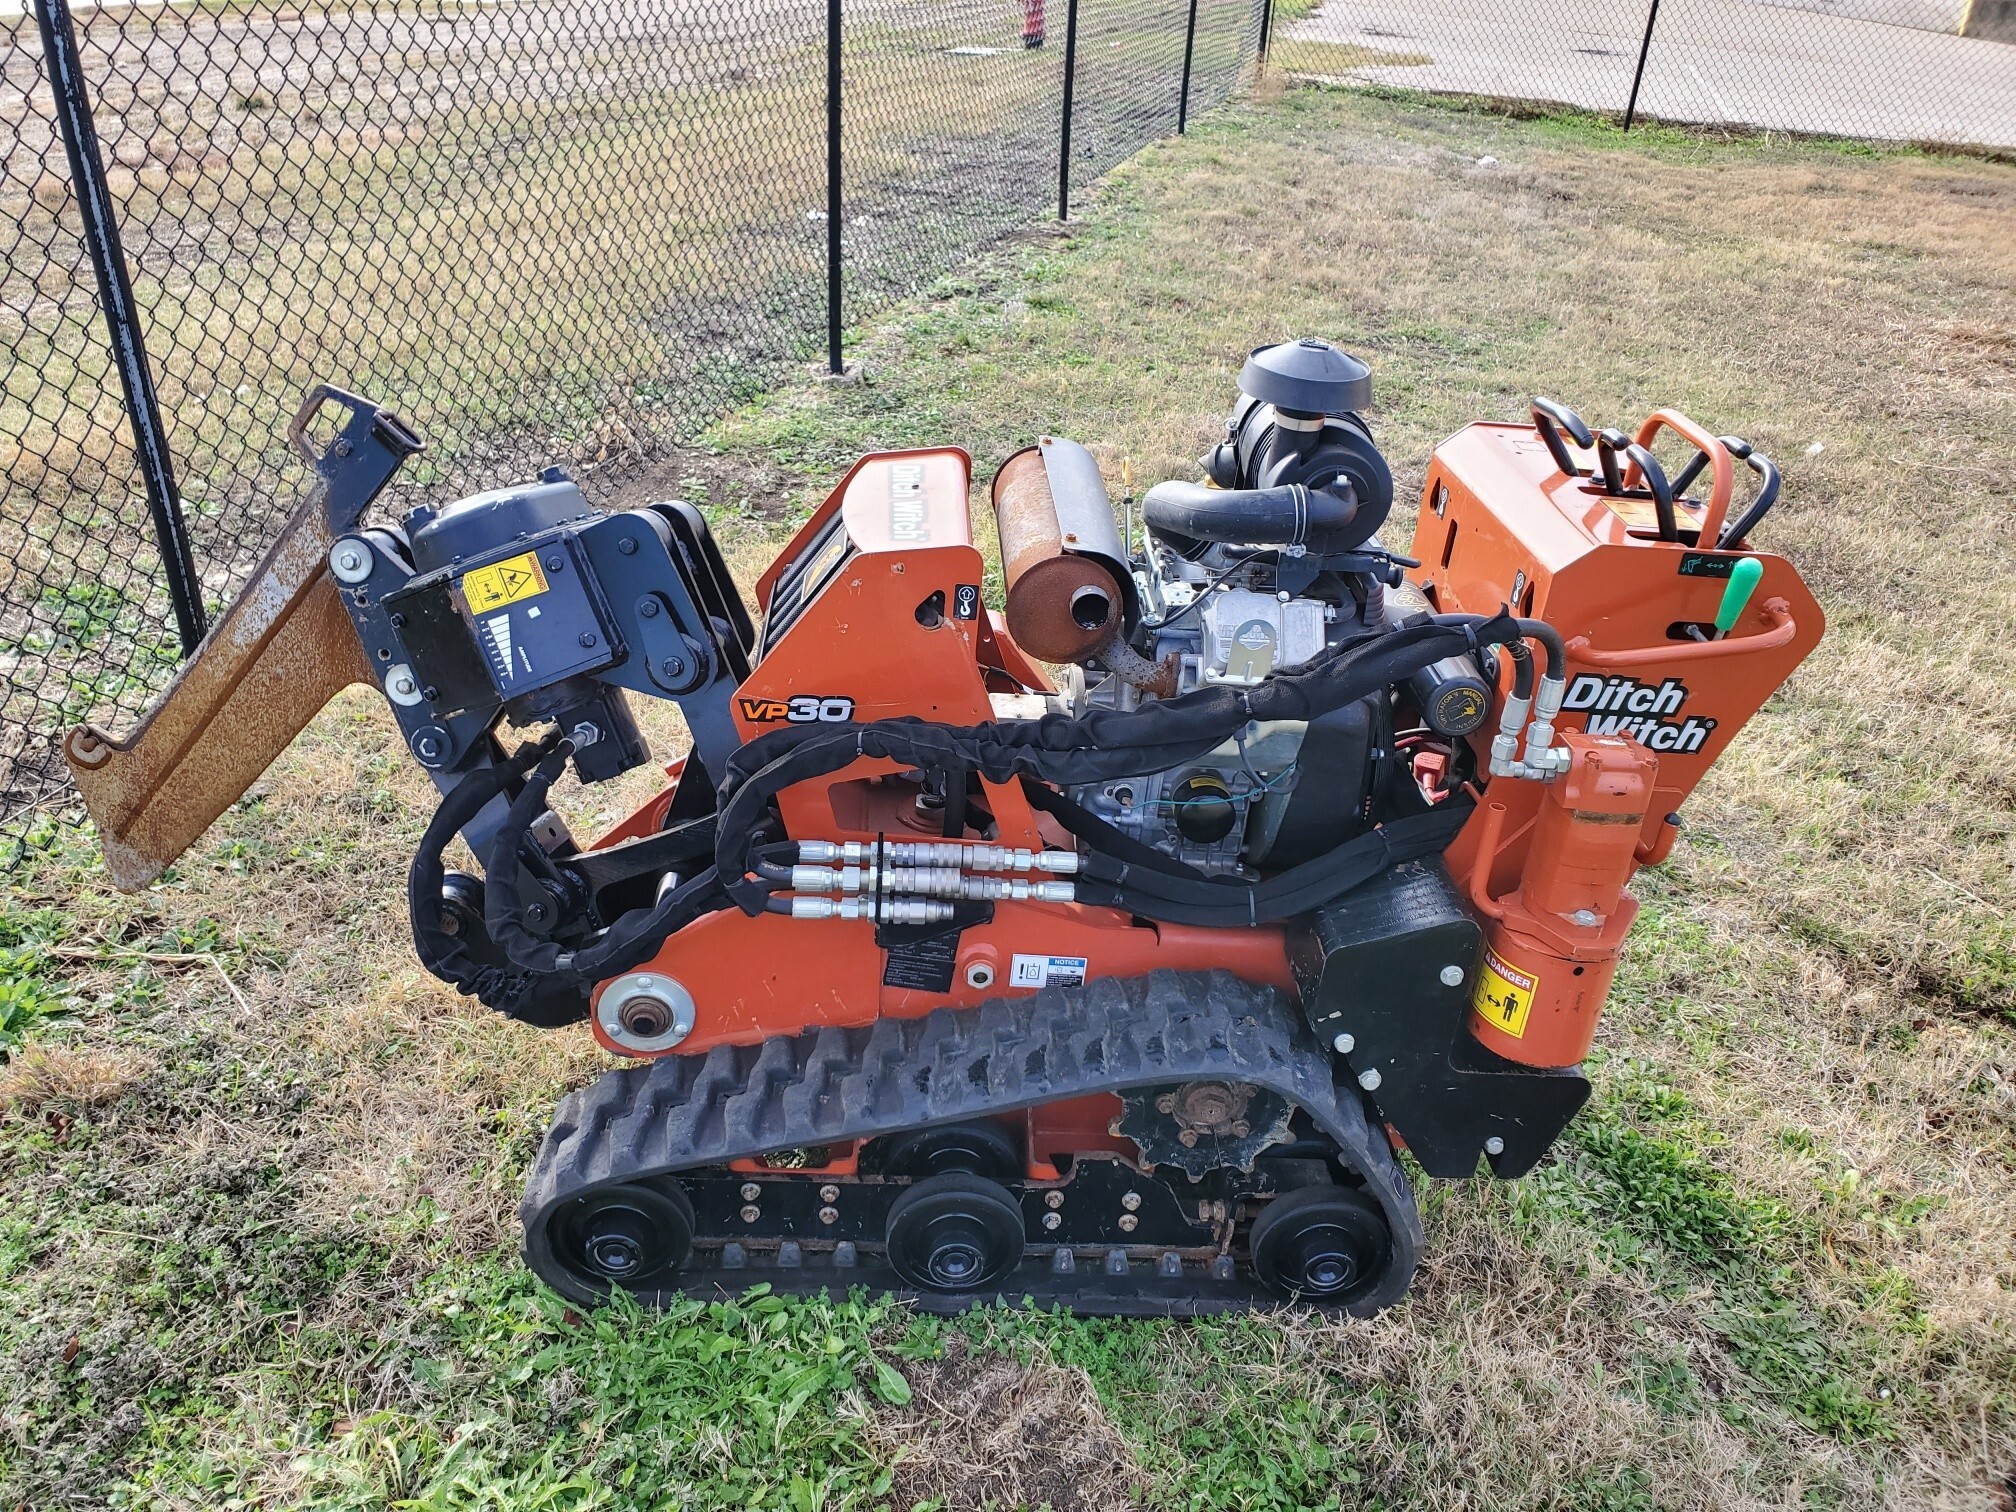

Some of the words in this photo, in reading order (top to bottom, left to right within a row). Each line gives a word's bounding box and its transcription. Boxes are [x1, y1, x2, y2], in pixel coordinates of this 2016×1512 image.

[892, 465, 922, 498] Ditch
[530, 560, 546, 591] WARNING
[518, 646, 532, 673] AMPLITUDE
[743, 698, 852, 721] VP30
[1462, 690, 1483, 706] MANUAL
[1562, 676, 1683, 714] Ditch
[1490, 957, 1531, 989] DANGER
